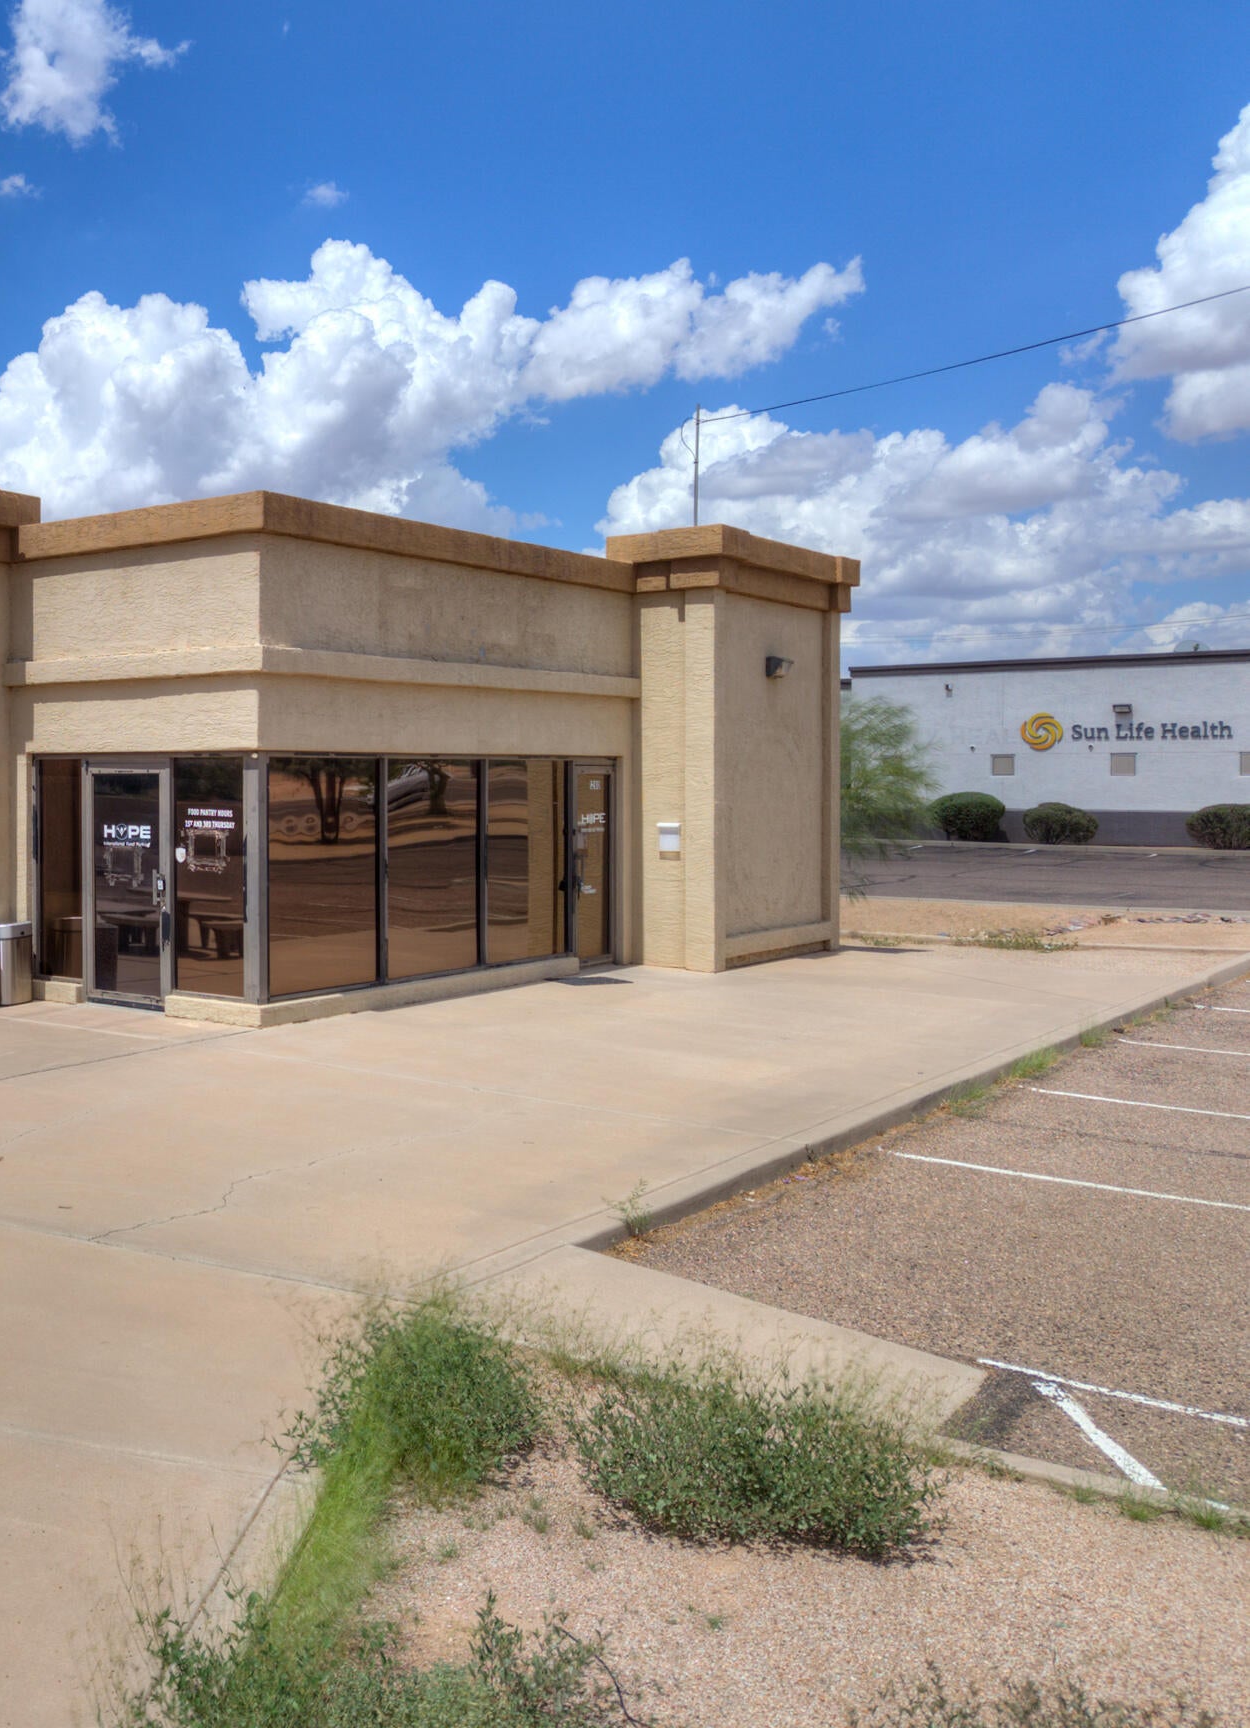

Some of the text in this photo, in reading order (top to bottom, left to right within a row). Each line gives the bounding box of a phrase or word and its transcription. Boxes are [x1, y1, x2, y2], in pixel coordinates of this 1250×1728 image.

[1071, 720, 1233, 740] Sun Life Health
[187, 808, 233, 818] FOOD PANTRY HOURS
[193, 820, 203, 828] AND
[211, 820, 236, 829] THURSDAY
[103, 823, 152, 840] HOPE
